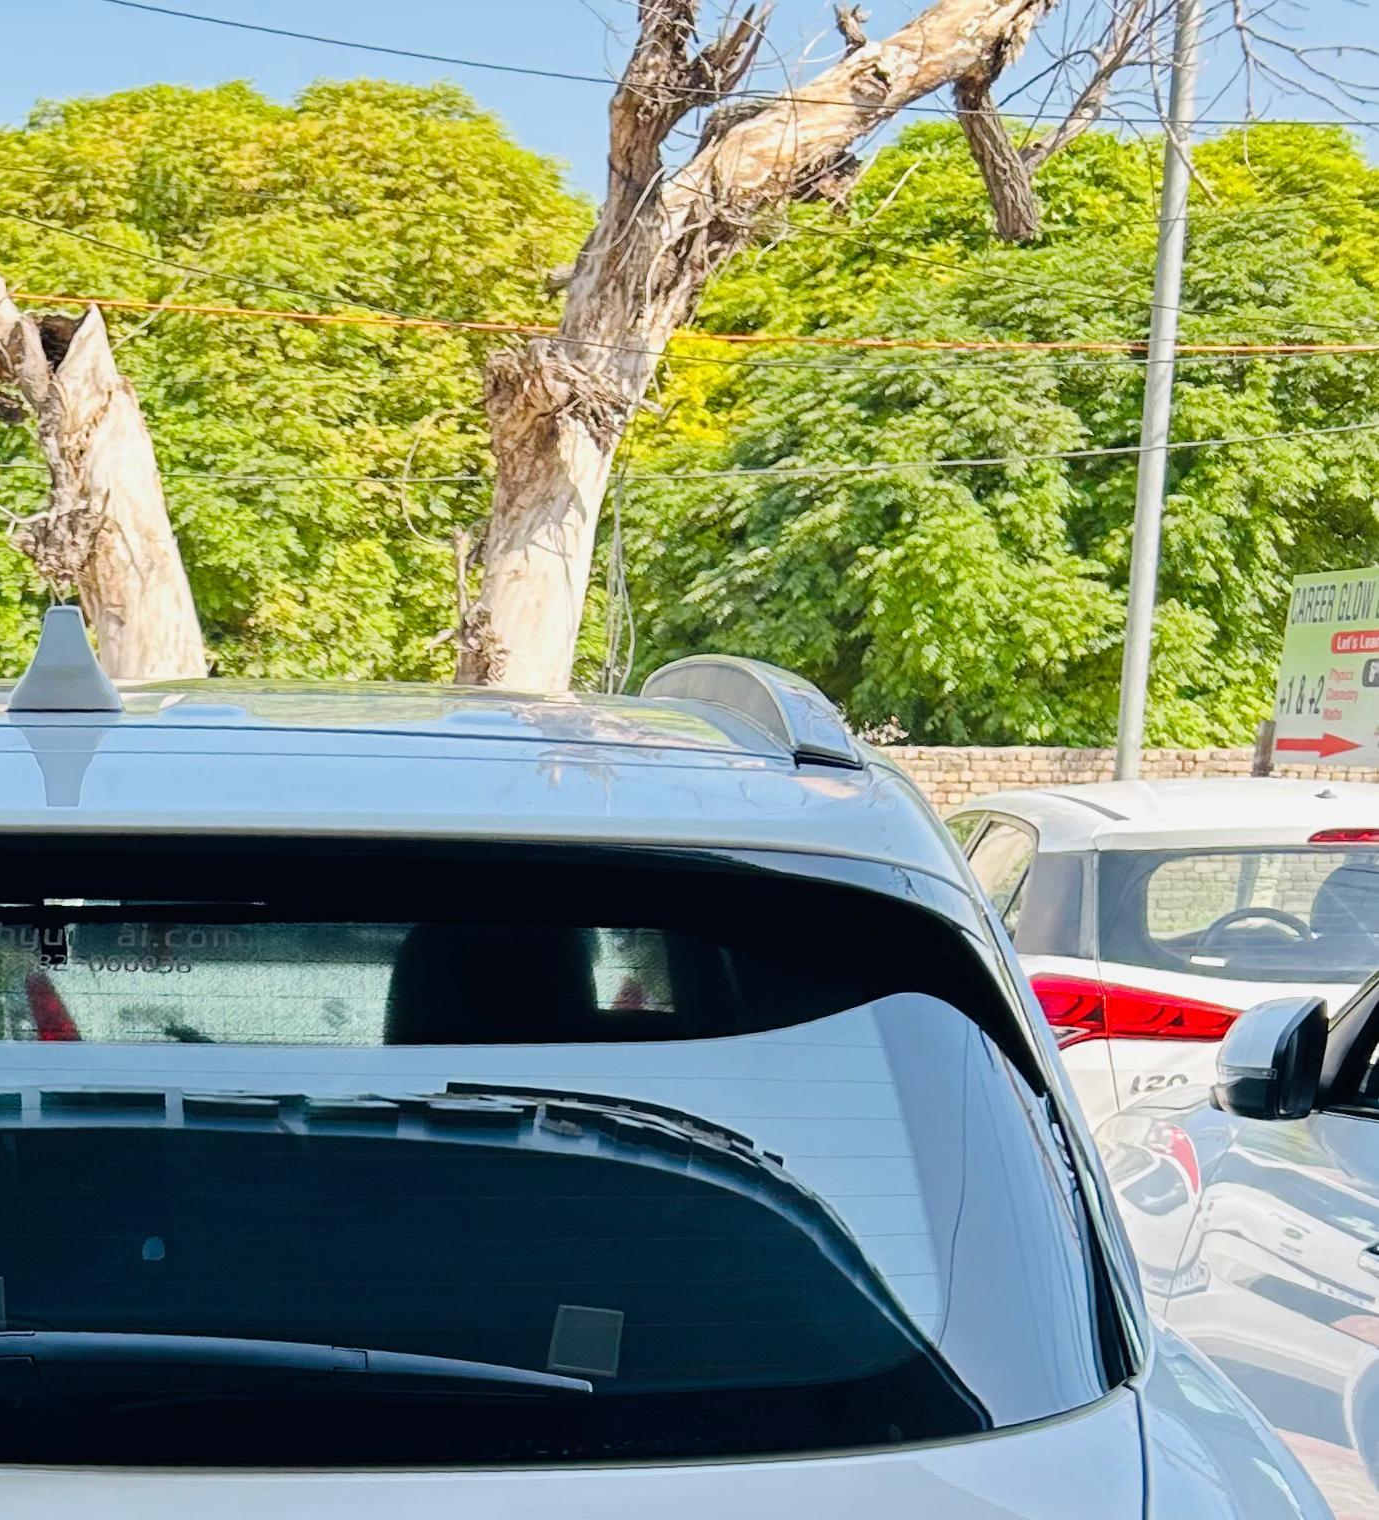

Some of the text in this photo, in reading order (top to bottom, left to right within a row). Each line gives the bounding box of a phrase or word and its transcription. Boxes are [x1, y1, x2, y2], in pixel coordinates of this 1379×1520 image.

[1290, 580, 1377, 625] CAREER GLOW
[1280, 675, 1296, 715] +1
[1308, 674, 1325, 715] +2
